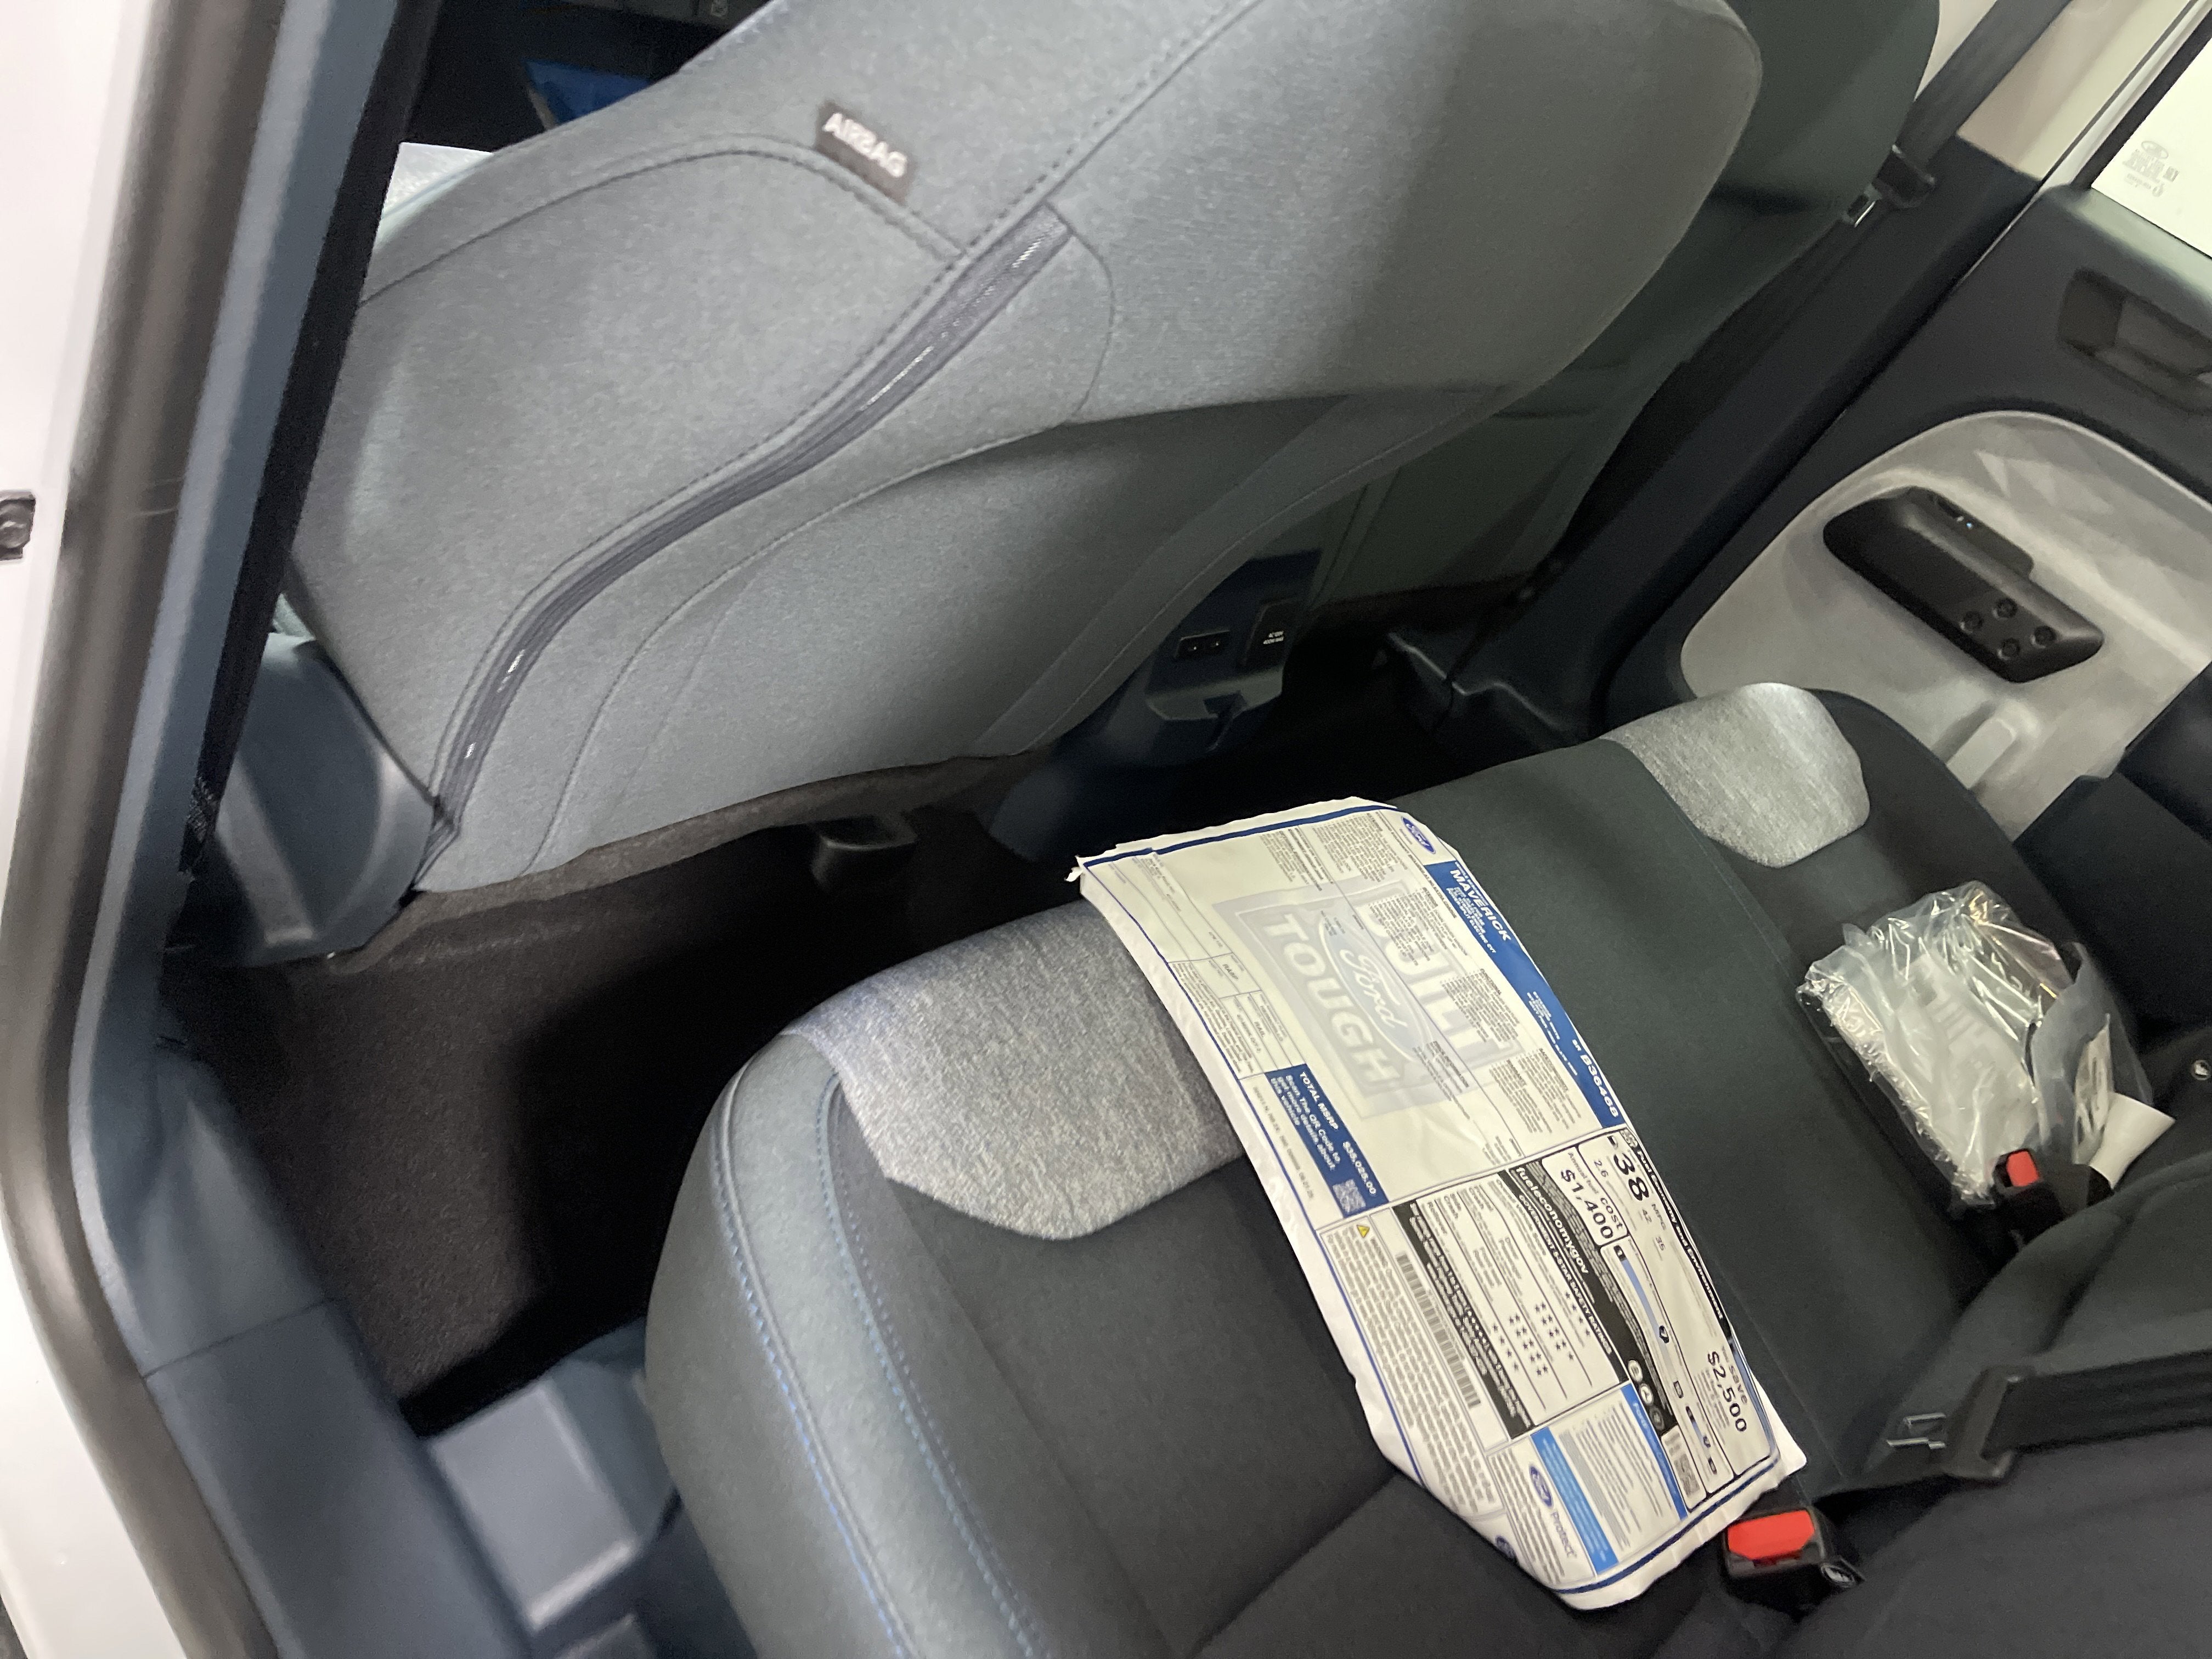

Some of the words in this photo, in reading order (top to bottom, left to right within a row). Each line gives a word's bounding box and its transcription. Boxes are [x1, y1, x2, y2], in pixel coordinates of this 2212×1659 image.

[822, 112, 908, 178] AIRBAG
[1449, 869, 1512, 941] MAVERICK
[1262, 912, 1401, 1082] TOUGH
[1339, 949, 1407, 1027] Ford
[1297, 1071, 1322, 1102] TOTAL
[1316, 1102, 1339, 1131] MSRP
[1579, 1053, 1620, 1118] B36468
[1307, 1113, 1322, 1129] QR
[1558, 1167, 1616, 1240] $1,400
[1611, 1150, 1652, 1202] 38
[1599, 1196, 1624, 1230] cost
[1640, 1207, 1653, 1223] 42
[1650, 1203, 1667, 1231] MPG
[1654, 1235, 1667, 1251] 35
[1705, 1350, 1750, 1434] $2,500
[1728, 1364, 1750, 1405] save
